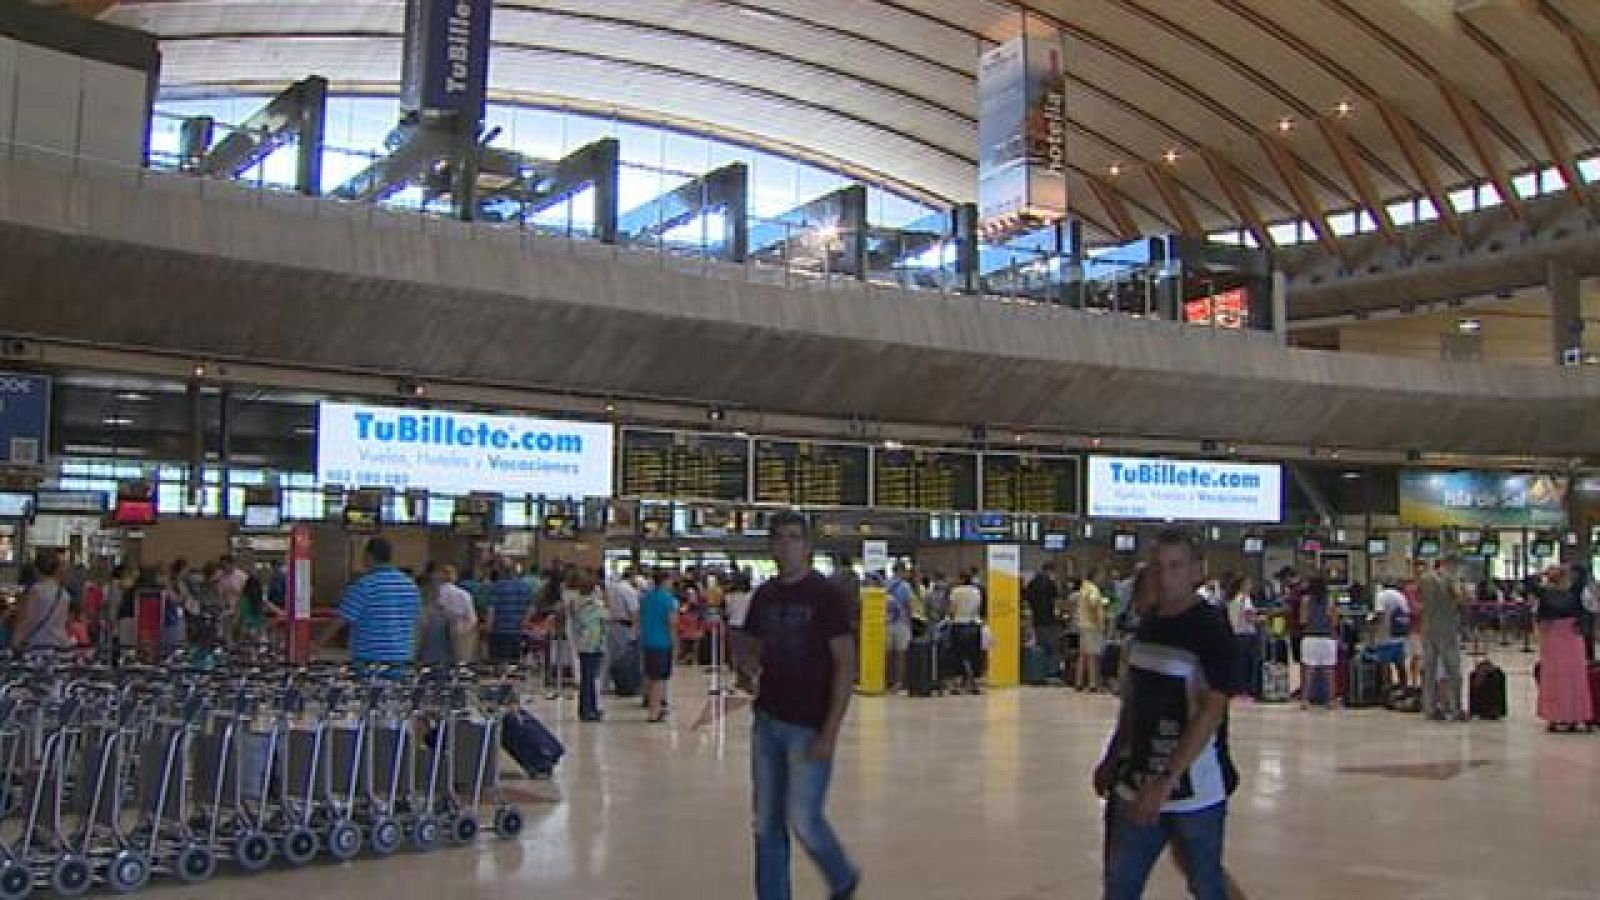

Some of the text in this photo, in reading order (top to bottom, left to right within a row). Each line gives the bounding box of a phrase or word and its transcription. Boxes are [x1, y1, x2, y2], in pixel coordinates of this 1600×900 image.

[445, 0, 471, 93] TuBille
[354, 411, 583, 453] TuBillete.com
[1110, 461, 1261, 489] TuBillete.com
